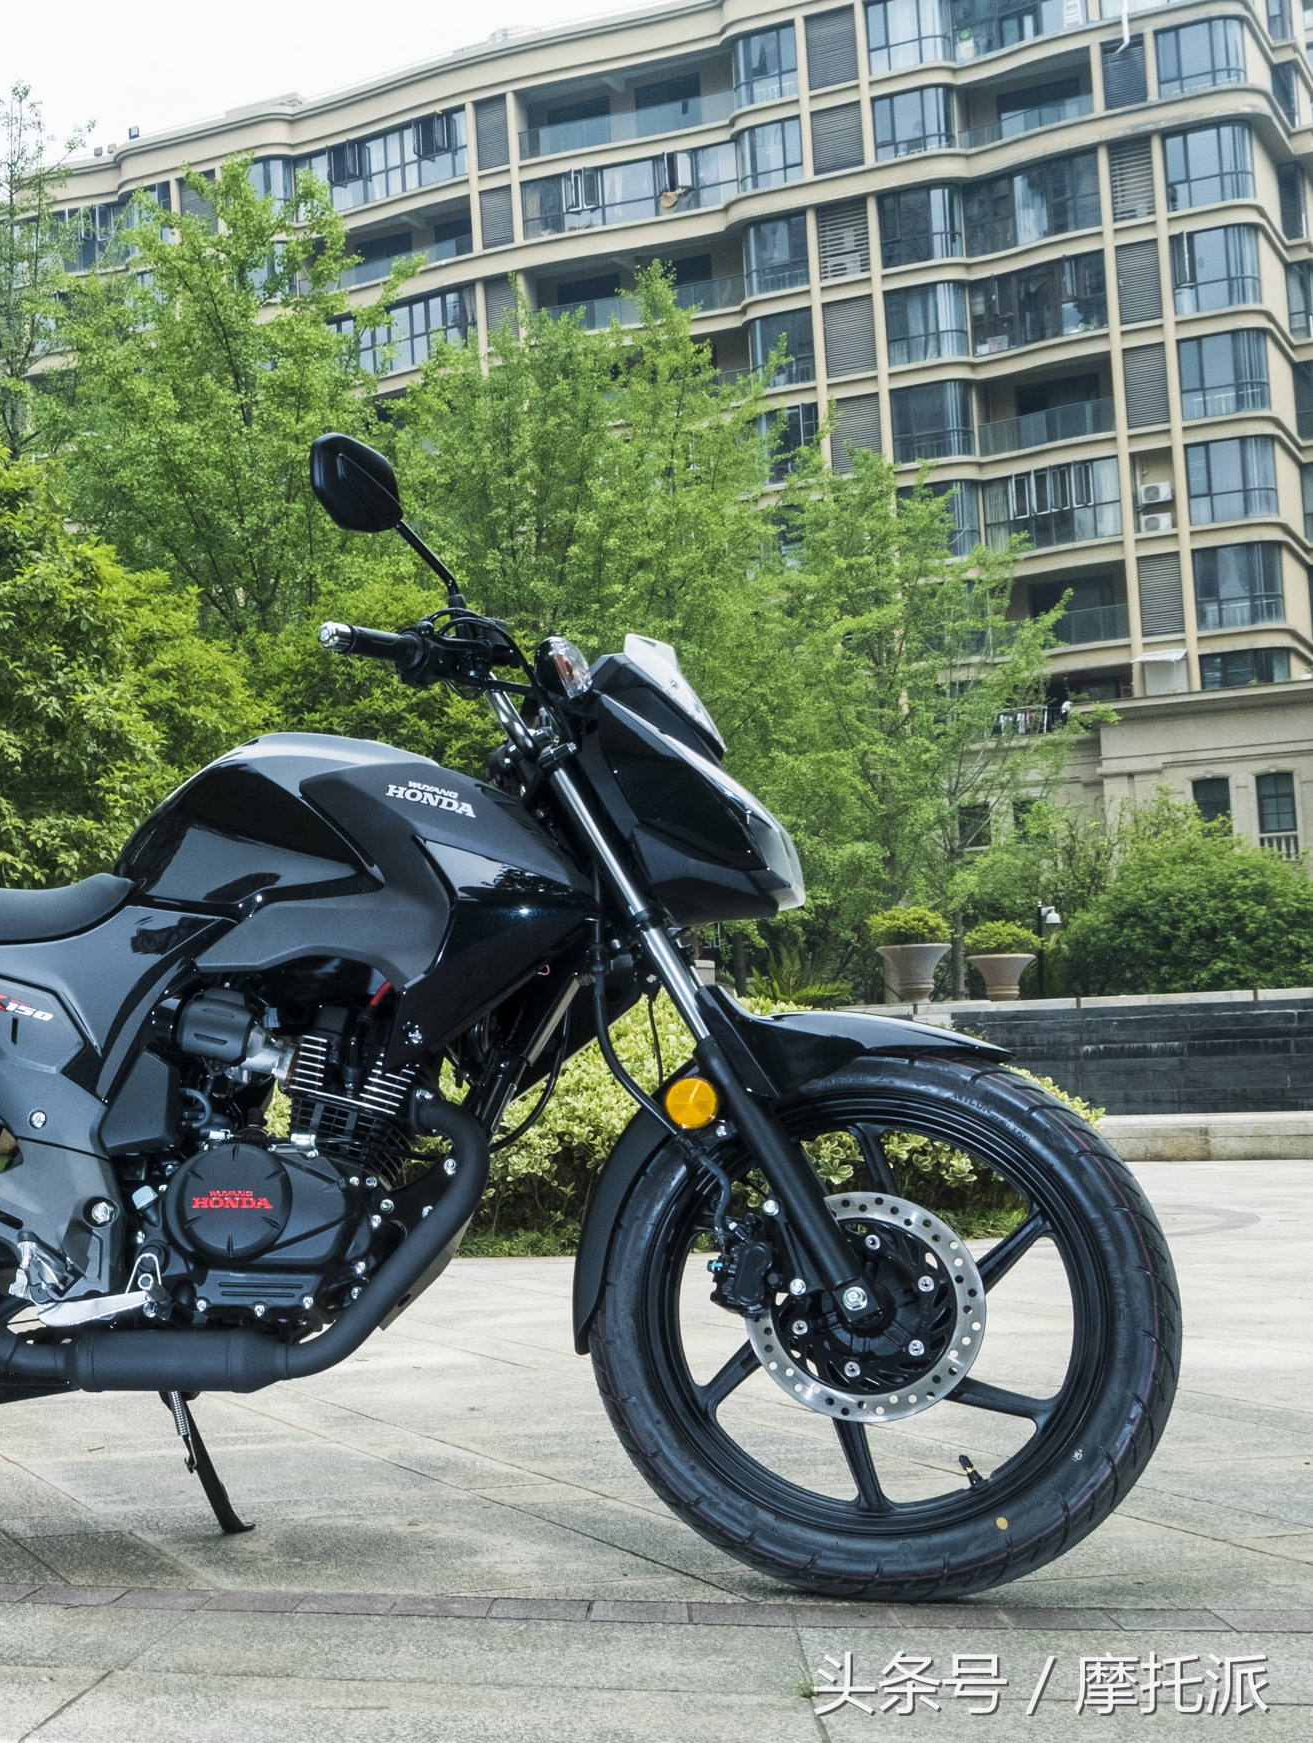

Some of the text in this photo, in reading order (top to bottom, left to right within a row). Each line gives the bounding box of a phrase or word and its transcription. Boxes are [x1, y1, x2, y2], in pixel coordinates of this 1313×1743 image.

[408, 780, 459, 799] WUYANG
[385, 784, 476, 819] HONDA
[191, 1197, 273, 1209] HONDA
